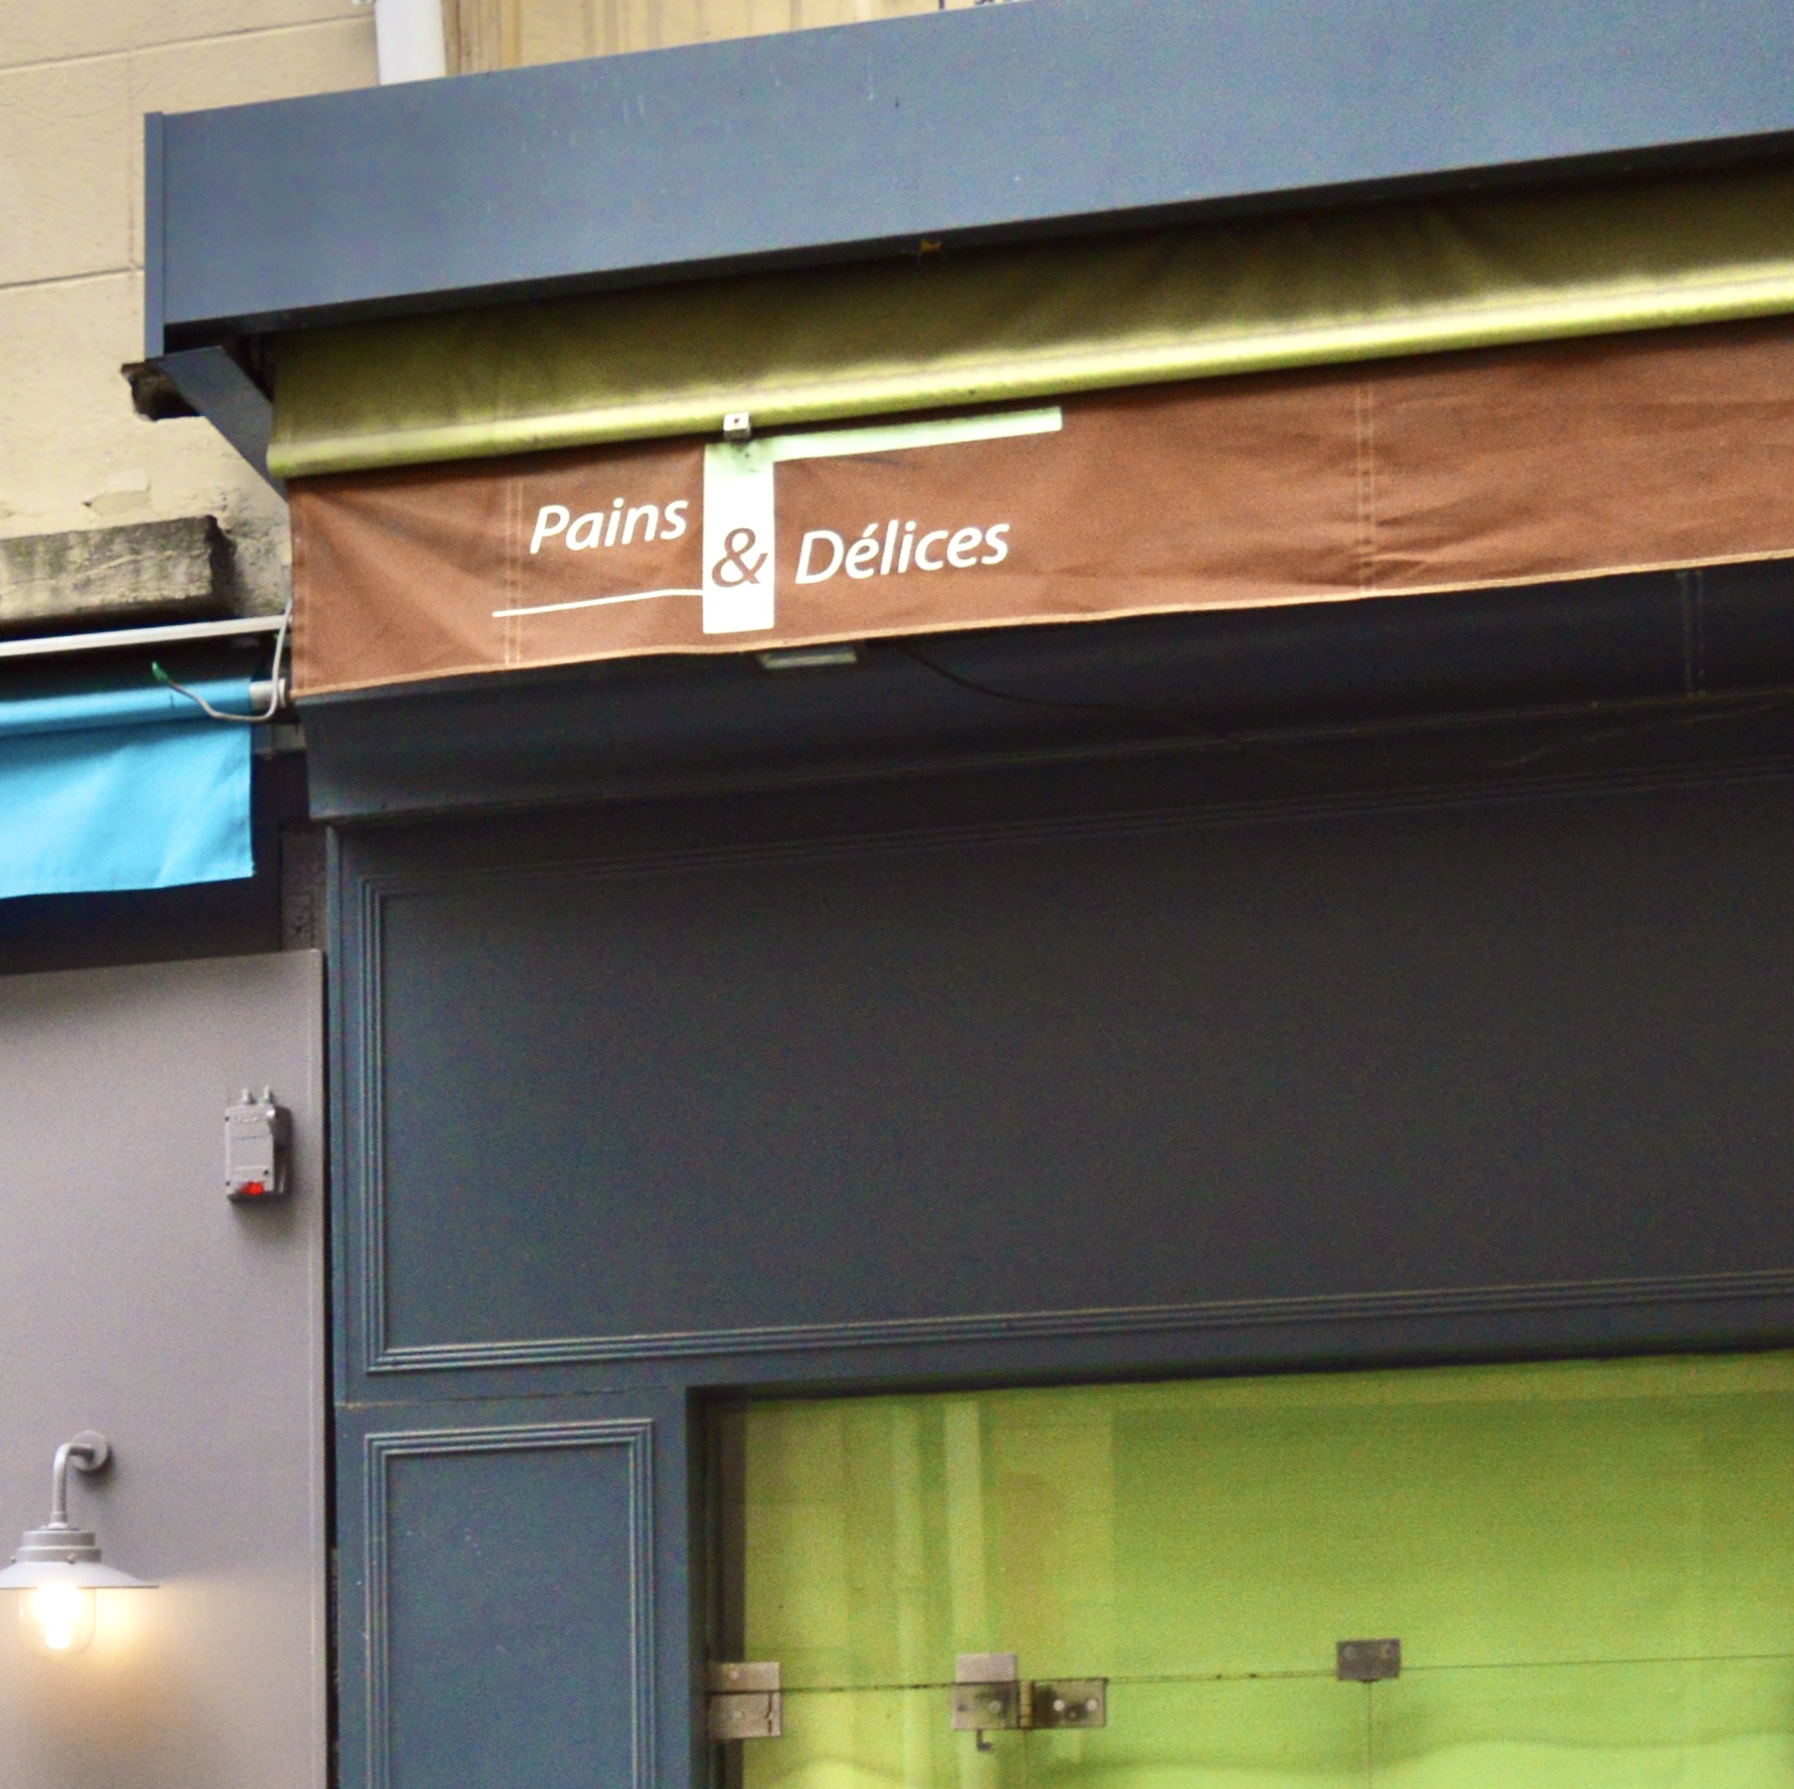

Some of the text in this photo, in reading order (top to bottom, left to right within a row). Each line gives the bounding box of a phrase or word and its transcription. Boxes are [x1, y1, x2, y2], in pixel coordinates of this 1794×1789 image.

[529, 497, 1011, 588] Pains & Délices
